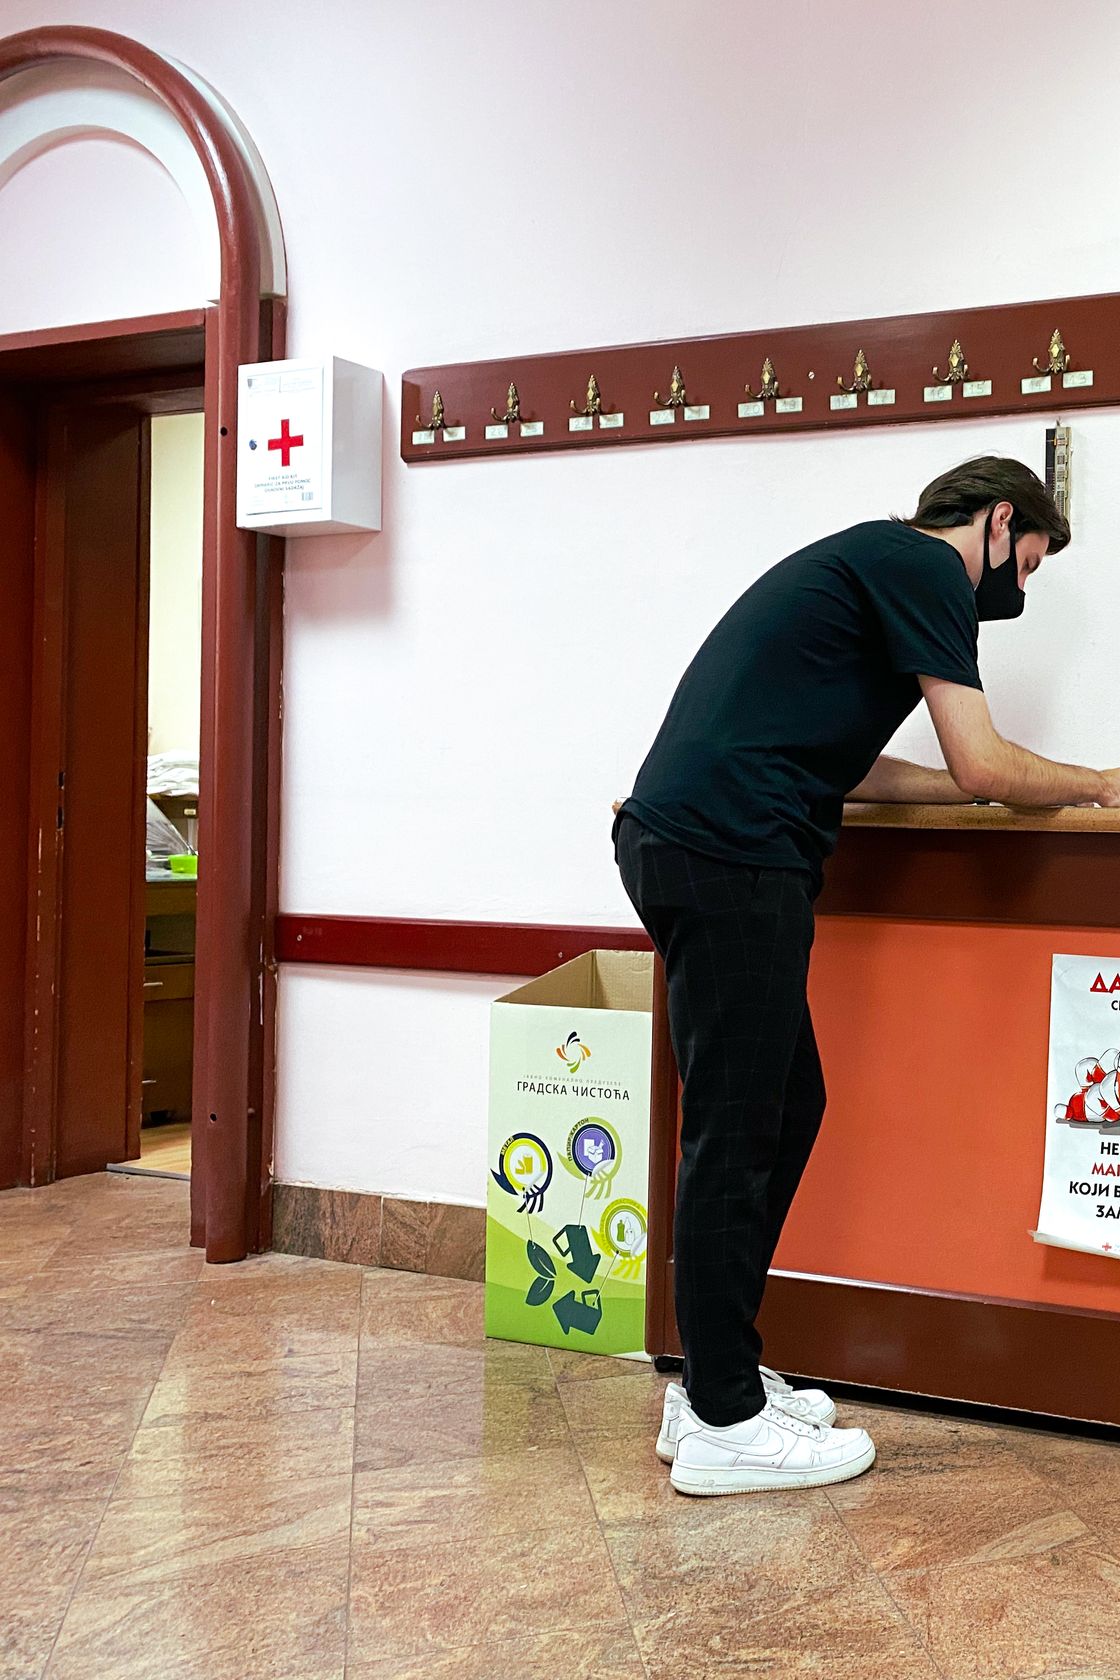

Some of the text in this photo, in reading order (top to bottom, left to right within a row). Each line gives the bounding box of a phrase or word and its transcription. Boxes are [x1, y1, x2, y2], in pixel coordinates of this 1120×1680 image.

[517, 1081, 630, 1101] ГРАДСКА ЧИСТОЋА
[1101, 1142, 1119, 1155] НЕ
[1069, 1182, 1109, 1197] КОЈИ
